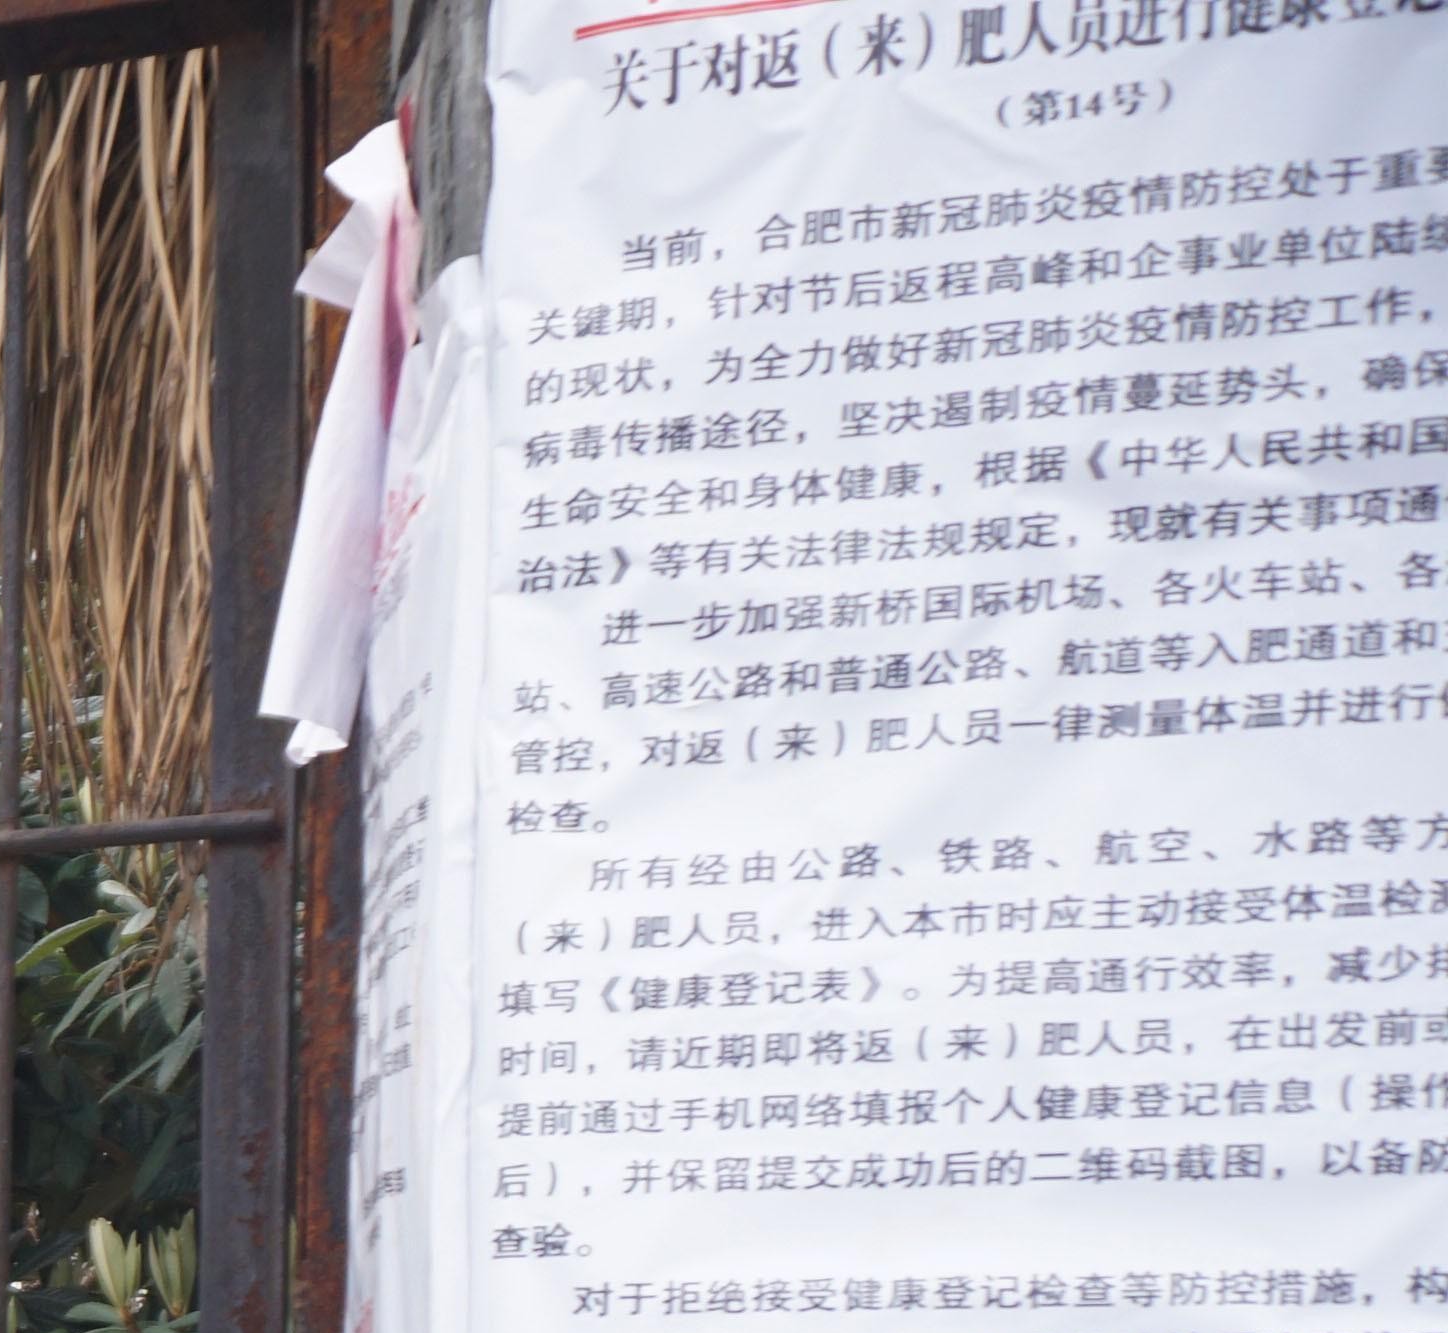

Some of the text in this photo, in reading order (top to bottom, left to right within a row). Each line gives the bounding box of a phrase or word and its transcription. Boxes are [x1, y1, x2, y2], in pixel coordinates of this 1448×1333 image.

[996, 78, 1174, 131] （第14号）
[517, 484, 1448, 595] 治法》等有关法律法规规定，现就有关事项通
[602, 550, 1448, 648] 进一步加强新桥国际机场、各火车站、各
[513, 618, 1448, 718] 站、高速公路和普通公路、航道等入肥通道和
[510, 684, 1448, 778] 管控，对返（来）肥人员一律测量体温并进行
[505, 799, 612, 837] 检查。
[492, 1224, 594, 1260] 查验。
